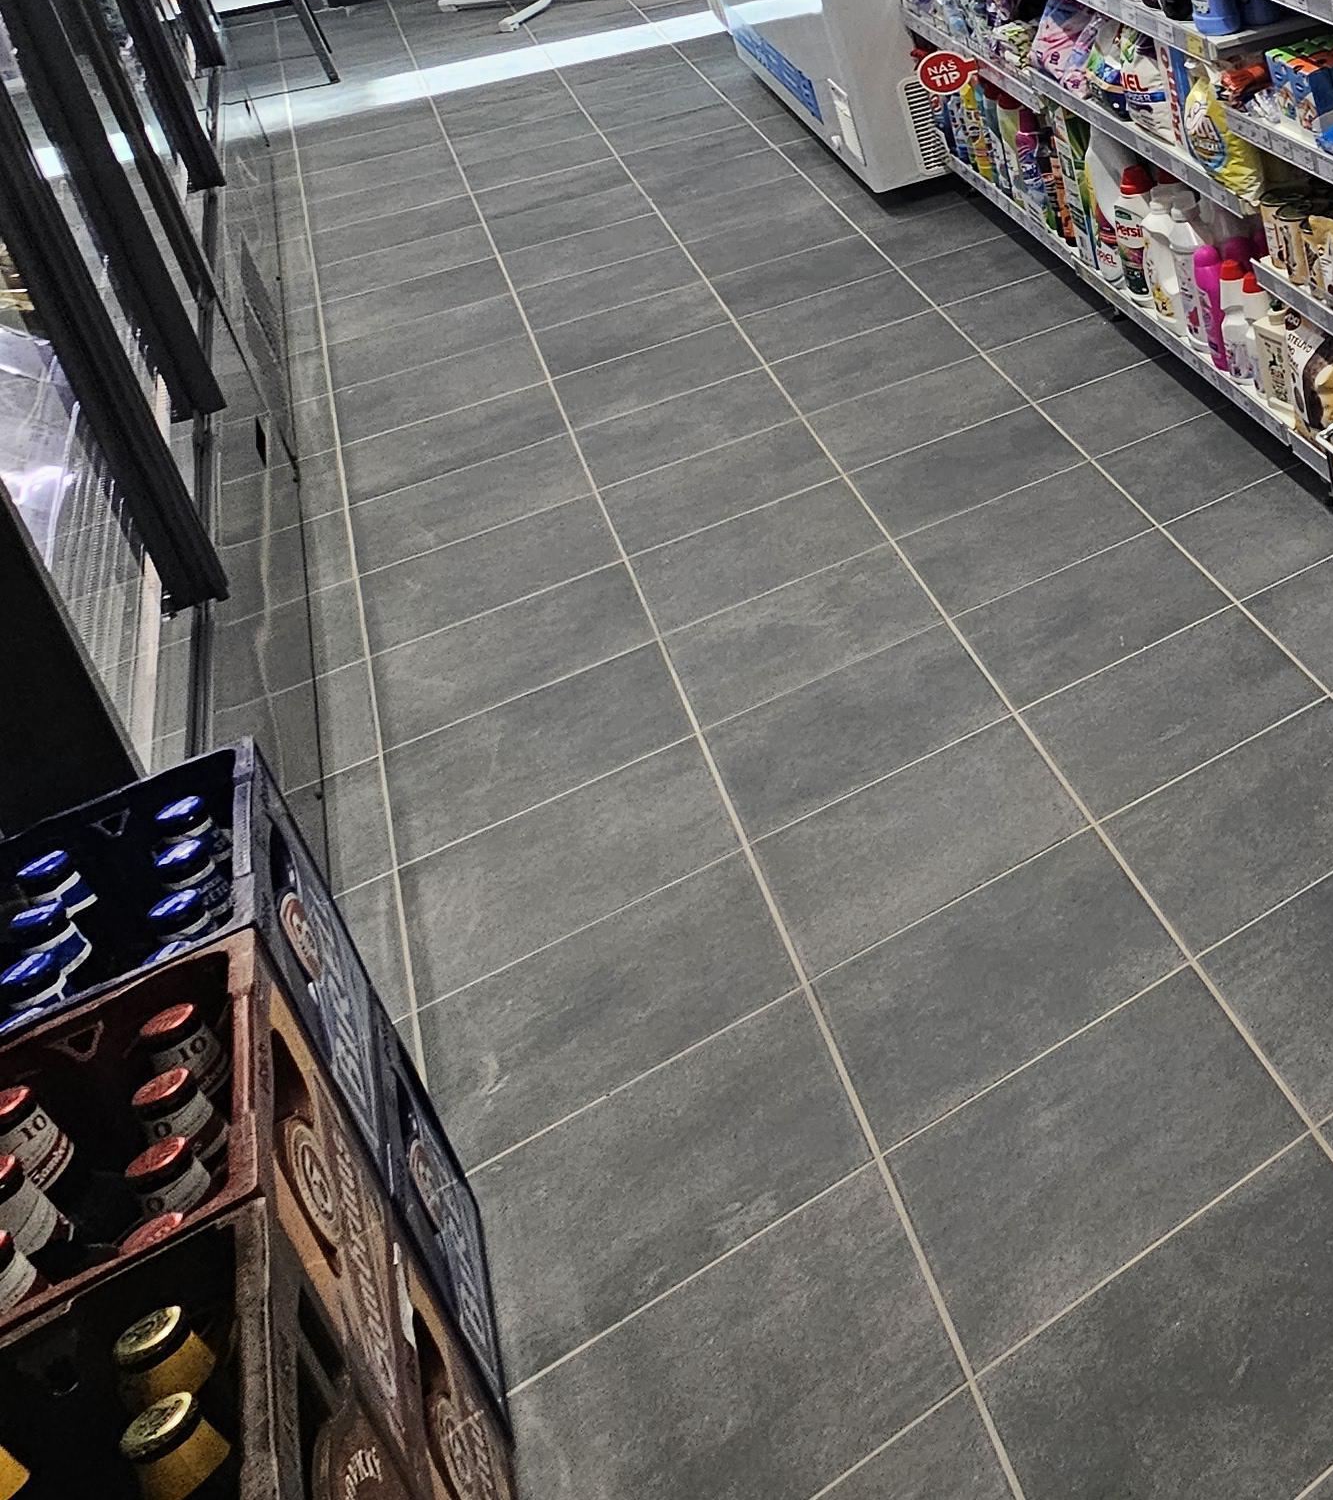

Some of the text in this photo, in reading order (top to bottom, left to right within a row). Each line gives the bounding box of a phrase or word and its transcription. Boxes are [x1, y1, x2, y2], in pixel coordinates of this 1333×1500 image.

[927, 60, 957, 76] NÁŠ
[930, 71, 961, 87] TIP
[1115, 220, 1143, 238] Persil
[180, 1035, 208, 1063] 10
[20, 1114, 48, 1142] 10
